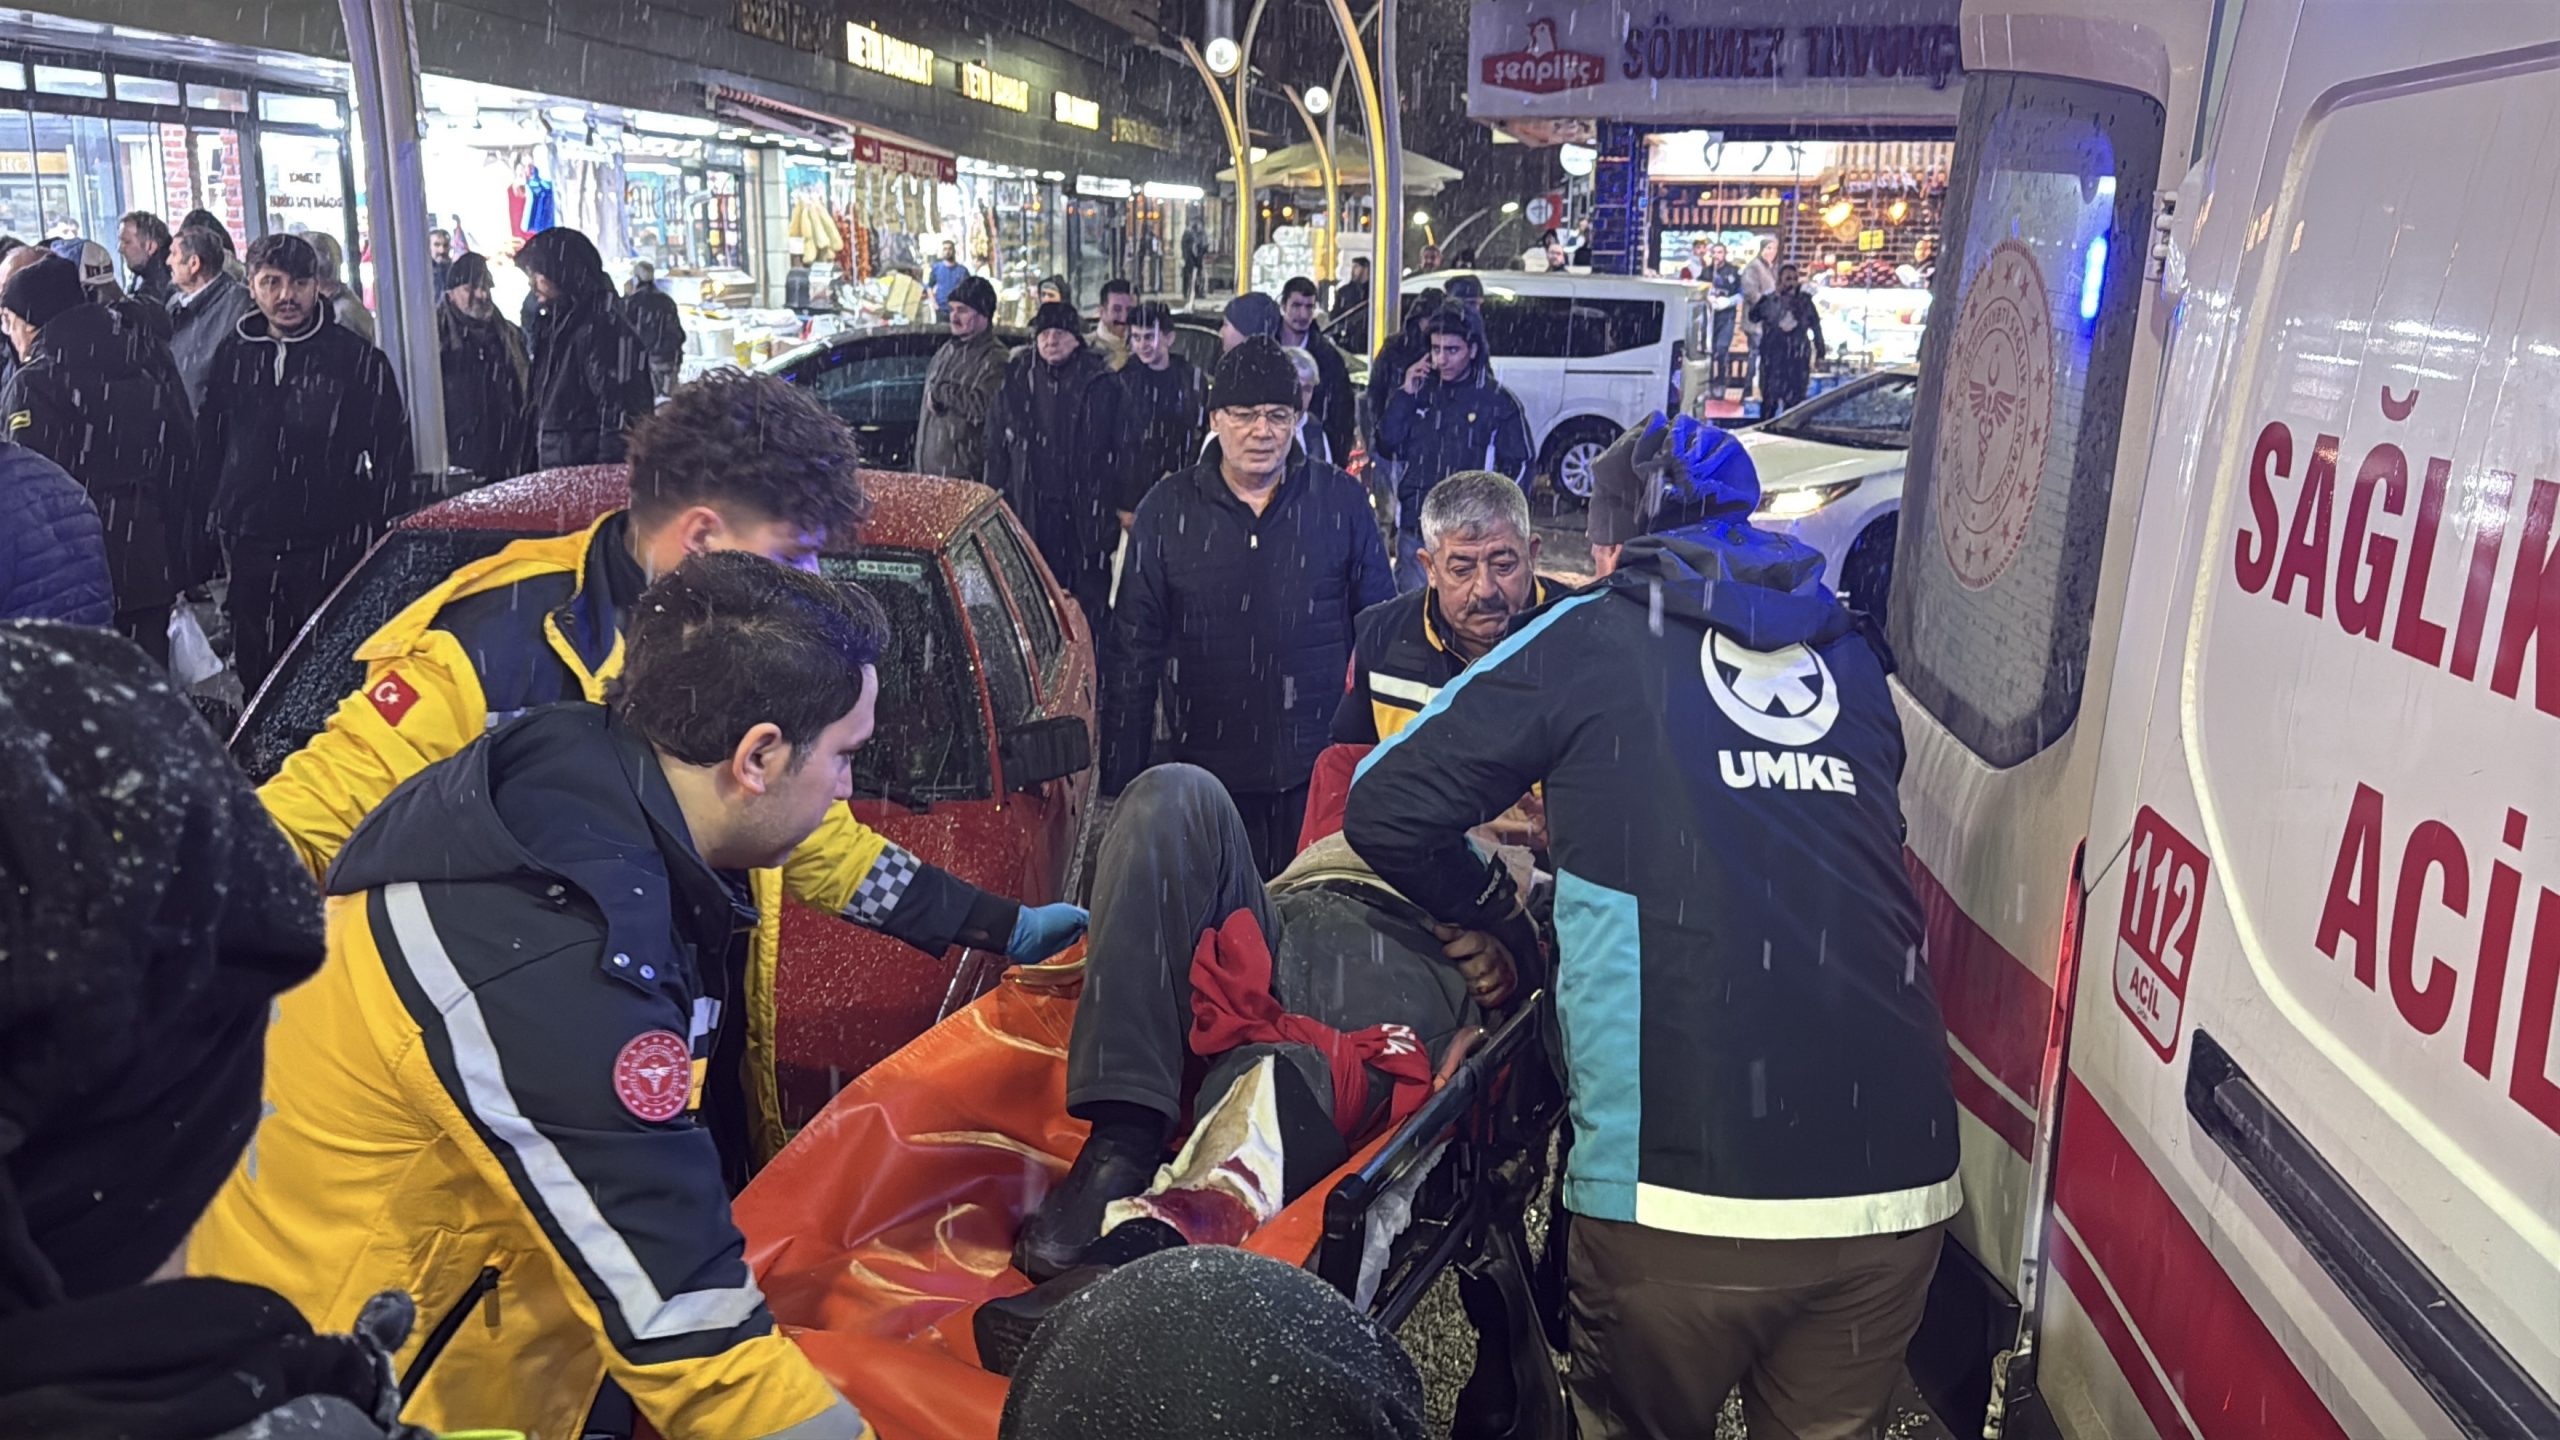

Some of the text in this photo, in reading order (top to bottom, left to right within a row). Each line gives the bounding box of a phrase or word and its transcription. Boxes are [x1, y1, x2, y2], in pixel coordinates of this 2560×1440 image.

[1623, 10, 1784, 80] SÖNMEZ
[2234, 385, 2560, 718] SAĞLIK
[1717, 749, 1857, 797] UMKE
[2130, 829, 2196, 982] 112
[2314, 780, 2560, 1137] ACİL
[2129, 966, 2161, 1022] ACİL
